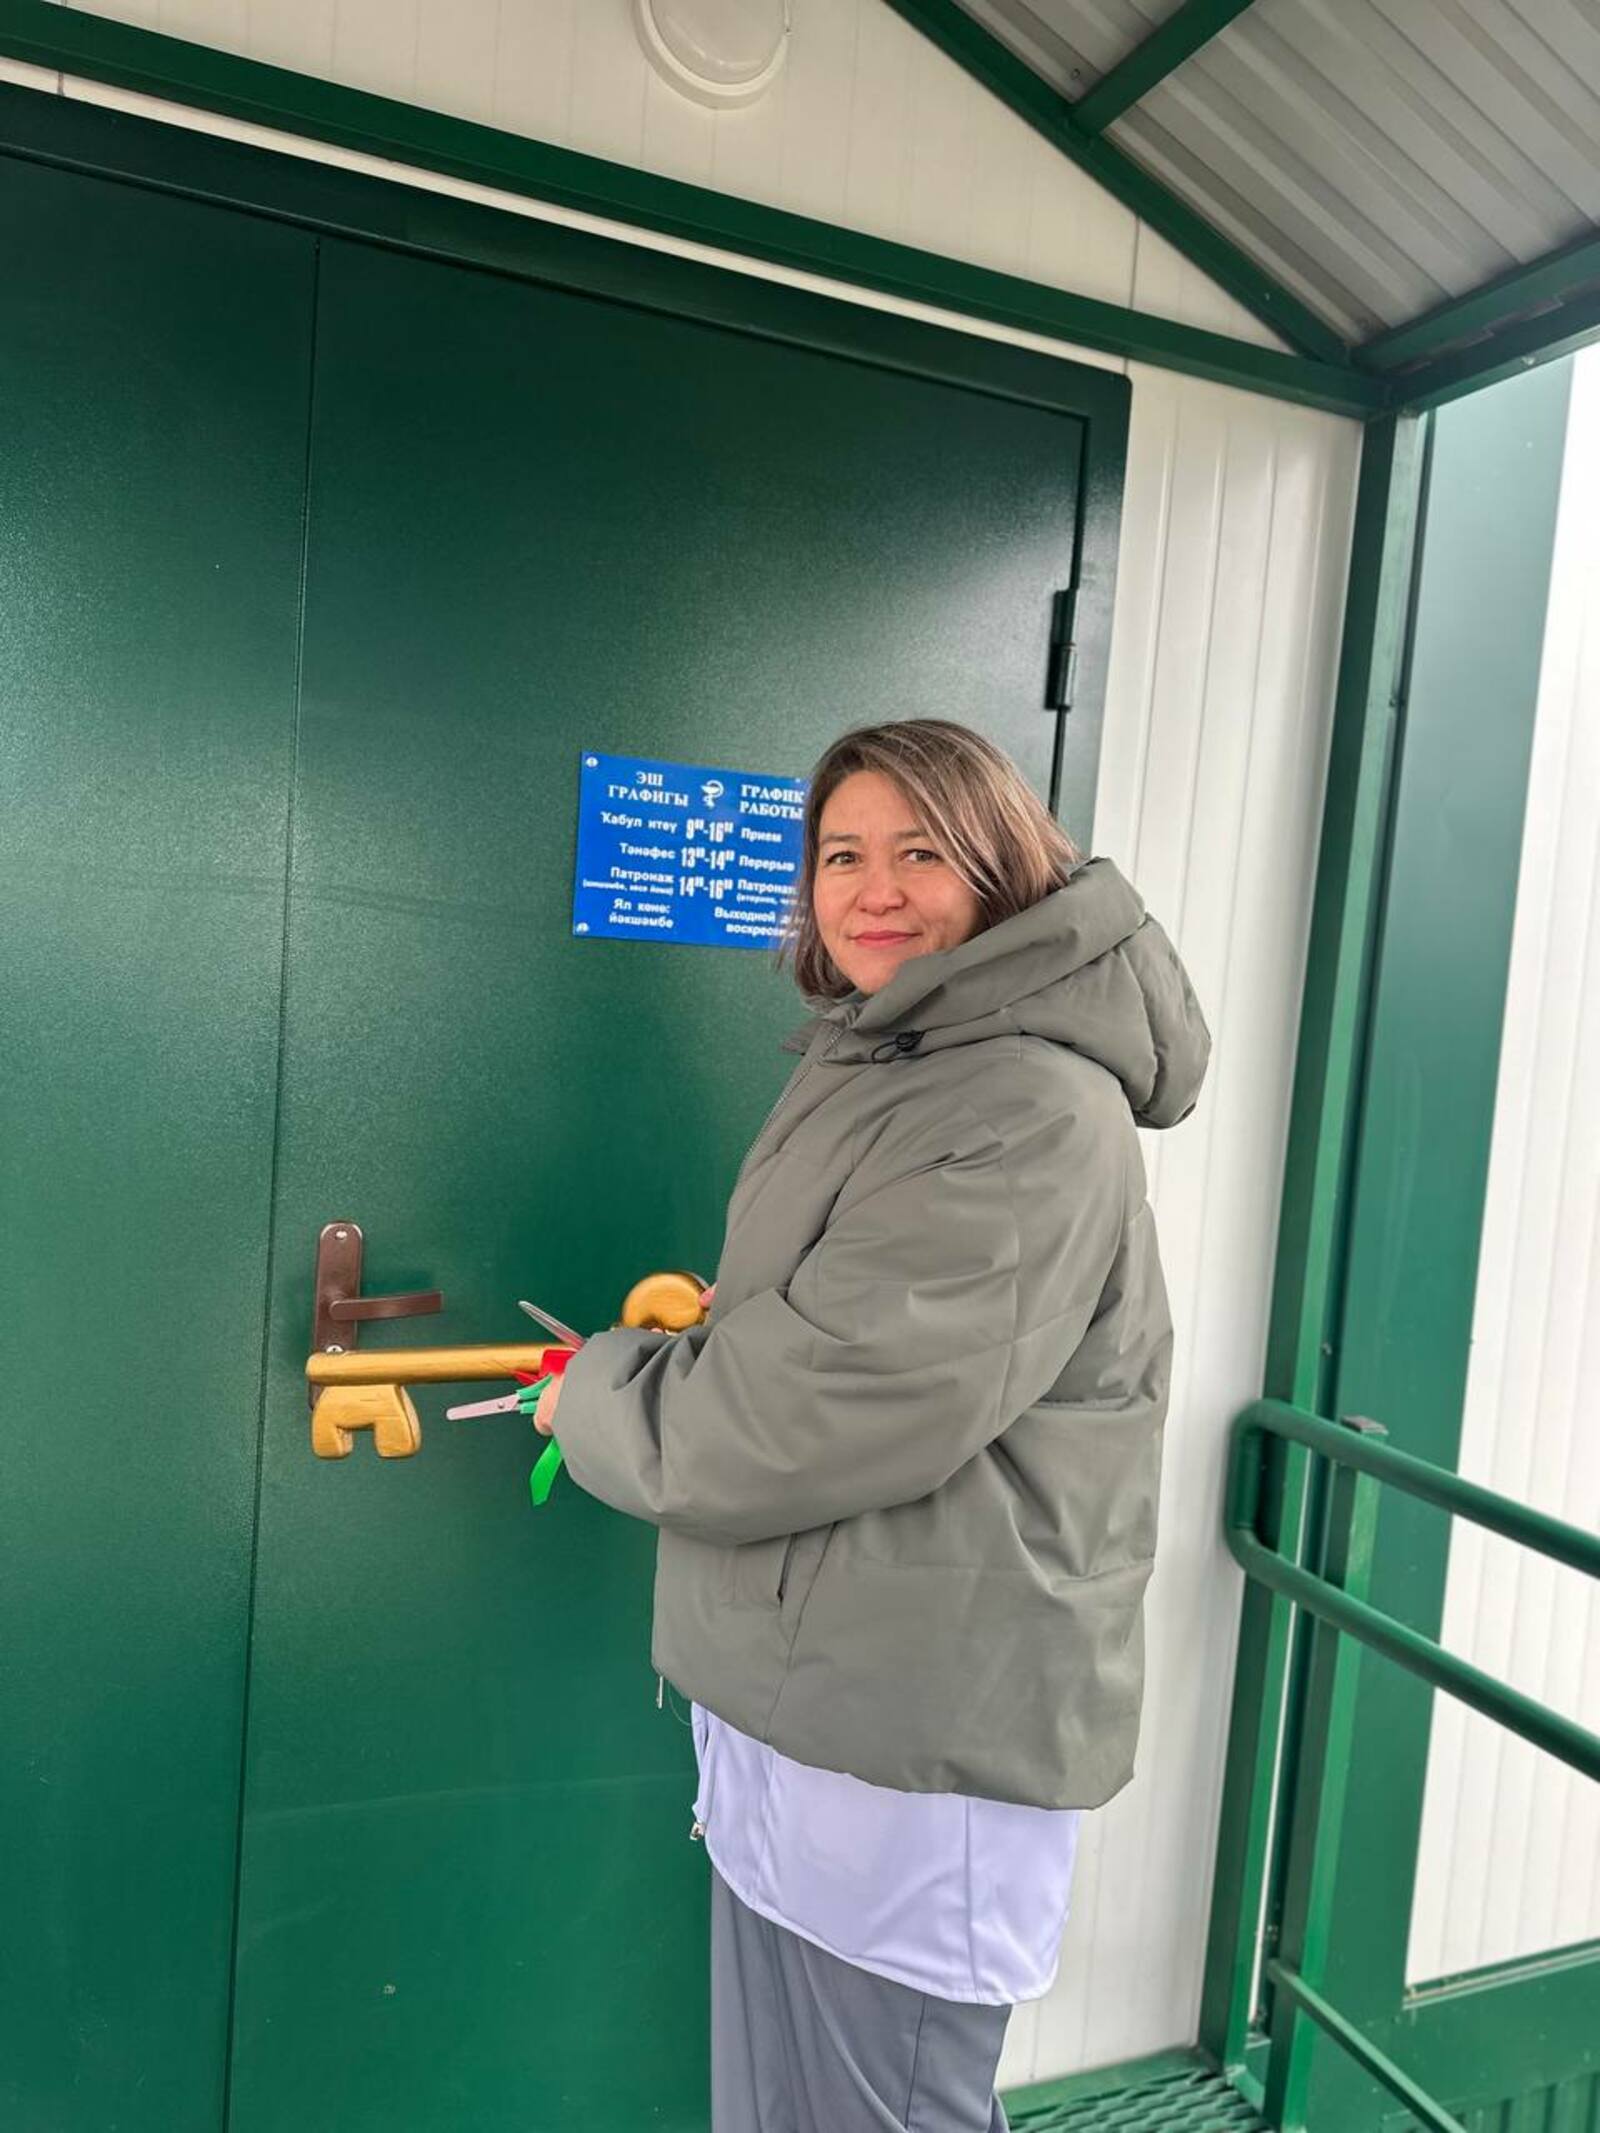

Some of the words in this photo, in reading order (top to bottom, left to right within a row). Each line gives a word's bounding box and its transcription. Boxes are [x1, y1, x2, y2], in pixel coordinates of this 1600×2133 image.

[635, 771, 663, 786] ЭШ
[607, 784, 689, 807] ГРАФИГЫ
[741, 784, 805, 803] ГРАФИК
[739, 800, 804, 820] РАБОТЫ
[739, 855, 795, 871] Перерыв
[610, 866, 675, 884] Патронаж
[613, 898, 632, 910] Ял
[714, 906, 776, 923] Выходной
